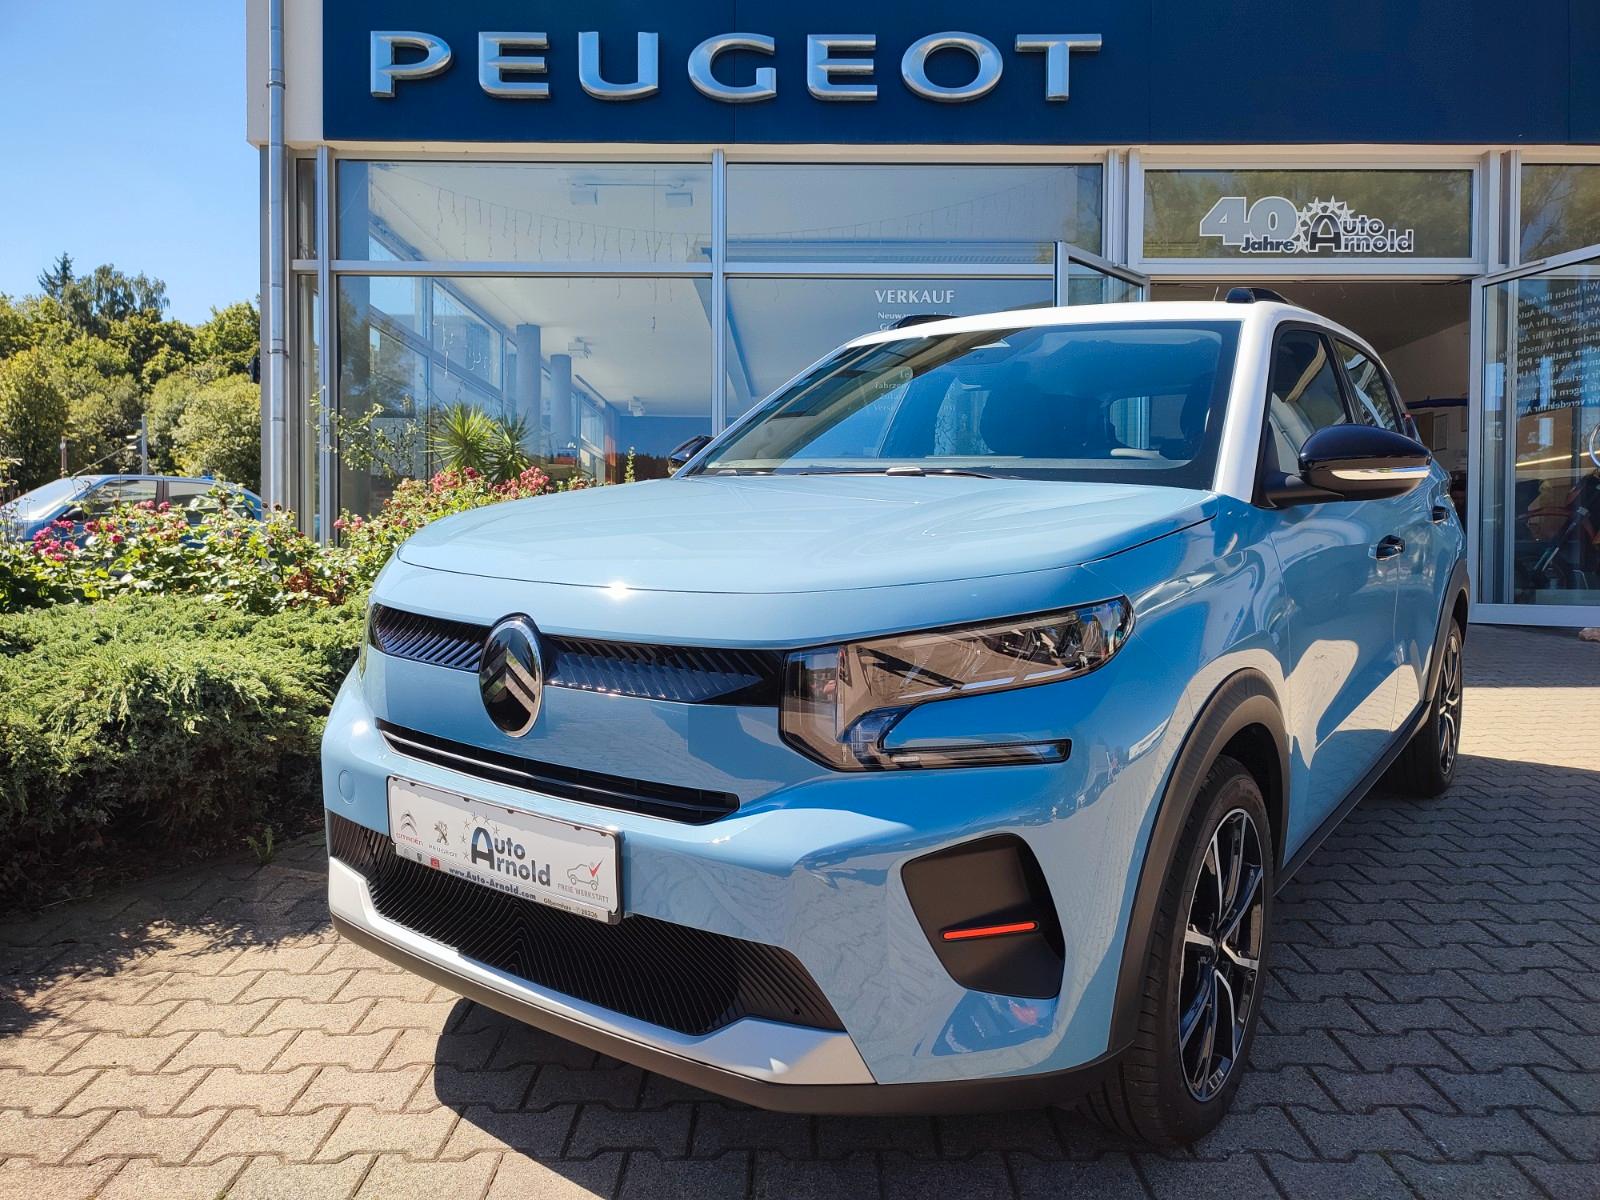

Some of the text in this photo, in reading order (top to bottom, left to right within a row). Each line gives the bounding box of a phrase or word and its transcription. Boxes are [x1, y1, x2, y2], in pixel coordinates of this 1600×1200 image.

[370, 30, 1103, 103] PEUGEOT
[1199, 195, 1298, 245] 40
[1308, 212, 1384, 252] Auto
[1240, 234, 1297, 253] Jahre
[874, 289, 955, 304] VERKAUF
[471, 826, 526, 869] Auto
[448, 867, 537, 901] www.Auto-Arnold.com
